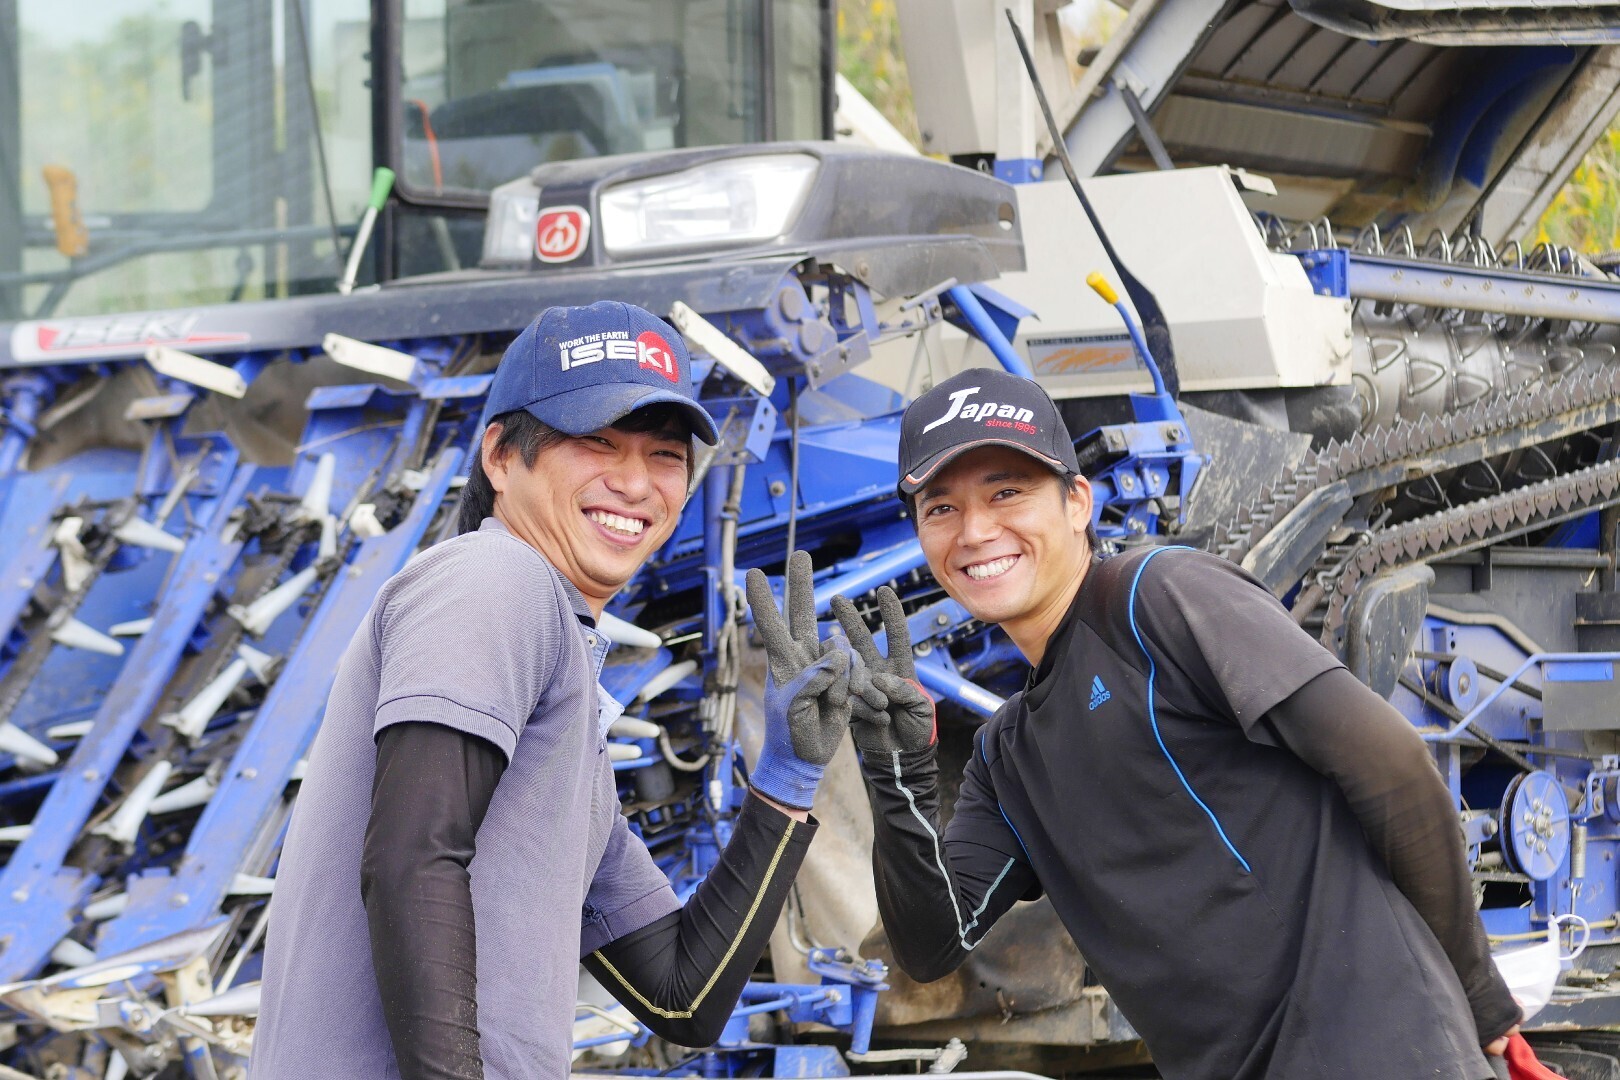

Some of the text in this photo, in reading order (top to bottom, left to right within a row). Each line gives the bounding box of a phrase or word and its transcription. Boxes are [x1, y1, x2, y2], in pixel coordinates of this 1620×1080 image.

[559, 331, 629, 350] WORK THE EARTH
[560, 339, 674, 373] ISEKI
[922, 386, 1035, 435] Japan
[985, 418, 1013, 429] since
[1088, 690, 1111, 711] adidas
